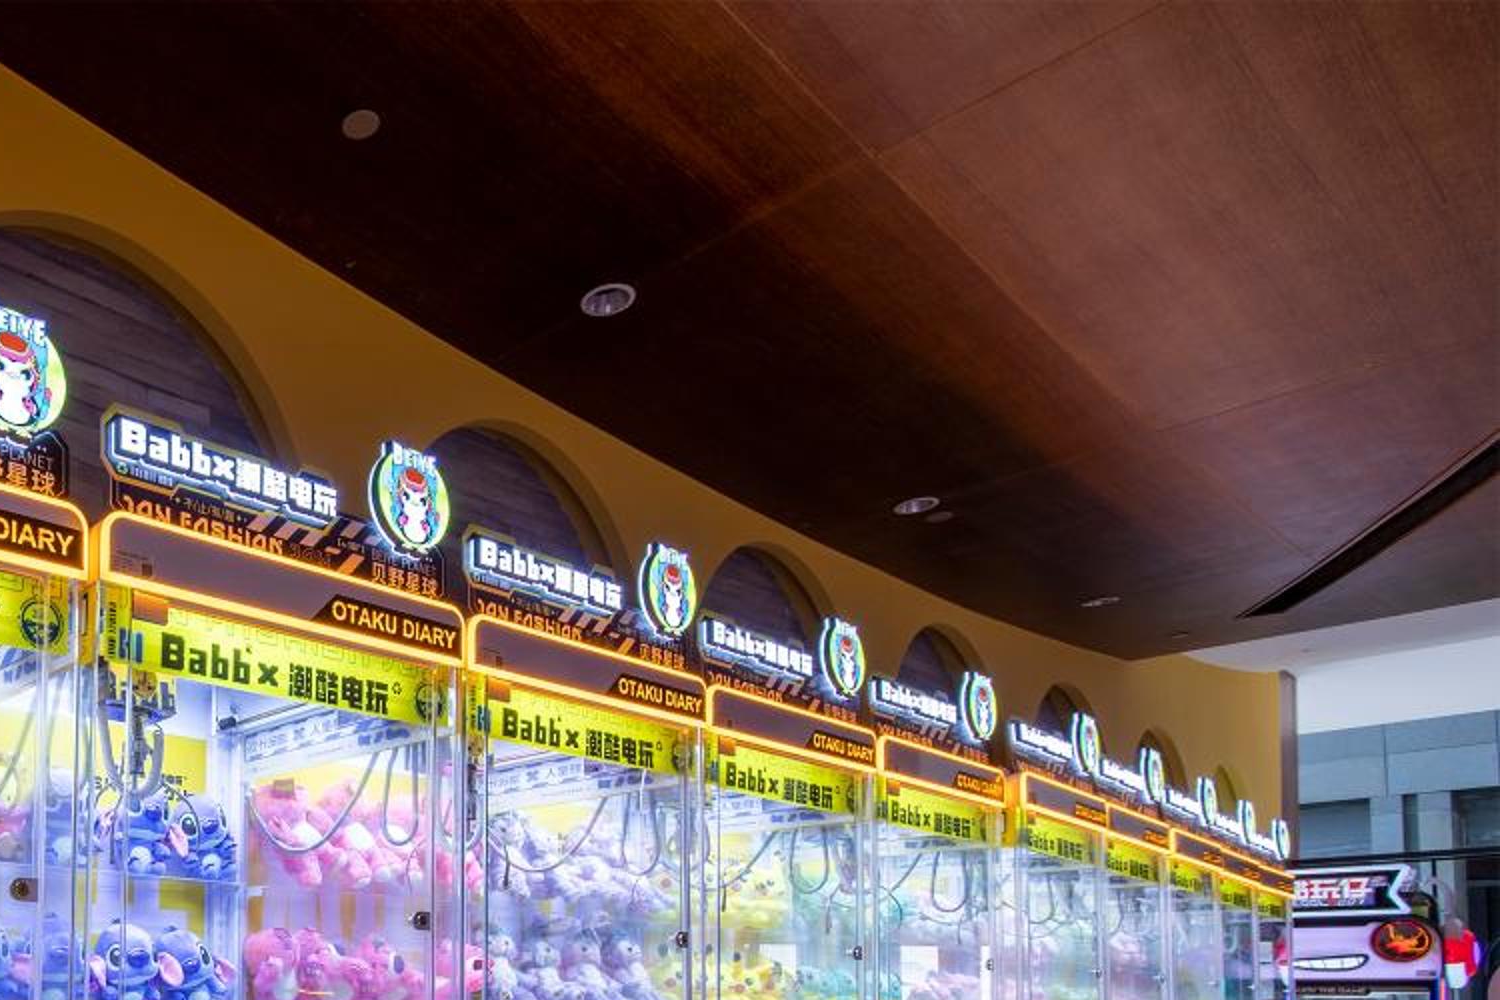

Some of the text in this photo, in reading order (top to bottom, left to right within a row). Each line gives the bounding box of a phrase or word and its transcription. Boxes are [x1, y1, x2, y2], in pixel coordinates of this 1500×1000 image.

[332, 600, 456, 649] OTAKU DIARY
[618, 677, 703, 714] OTAKU DIARY
